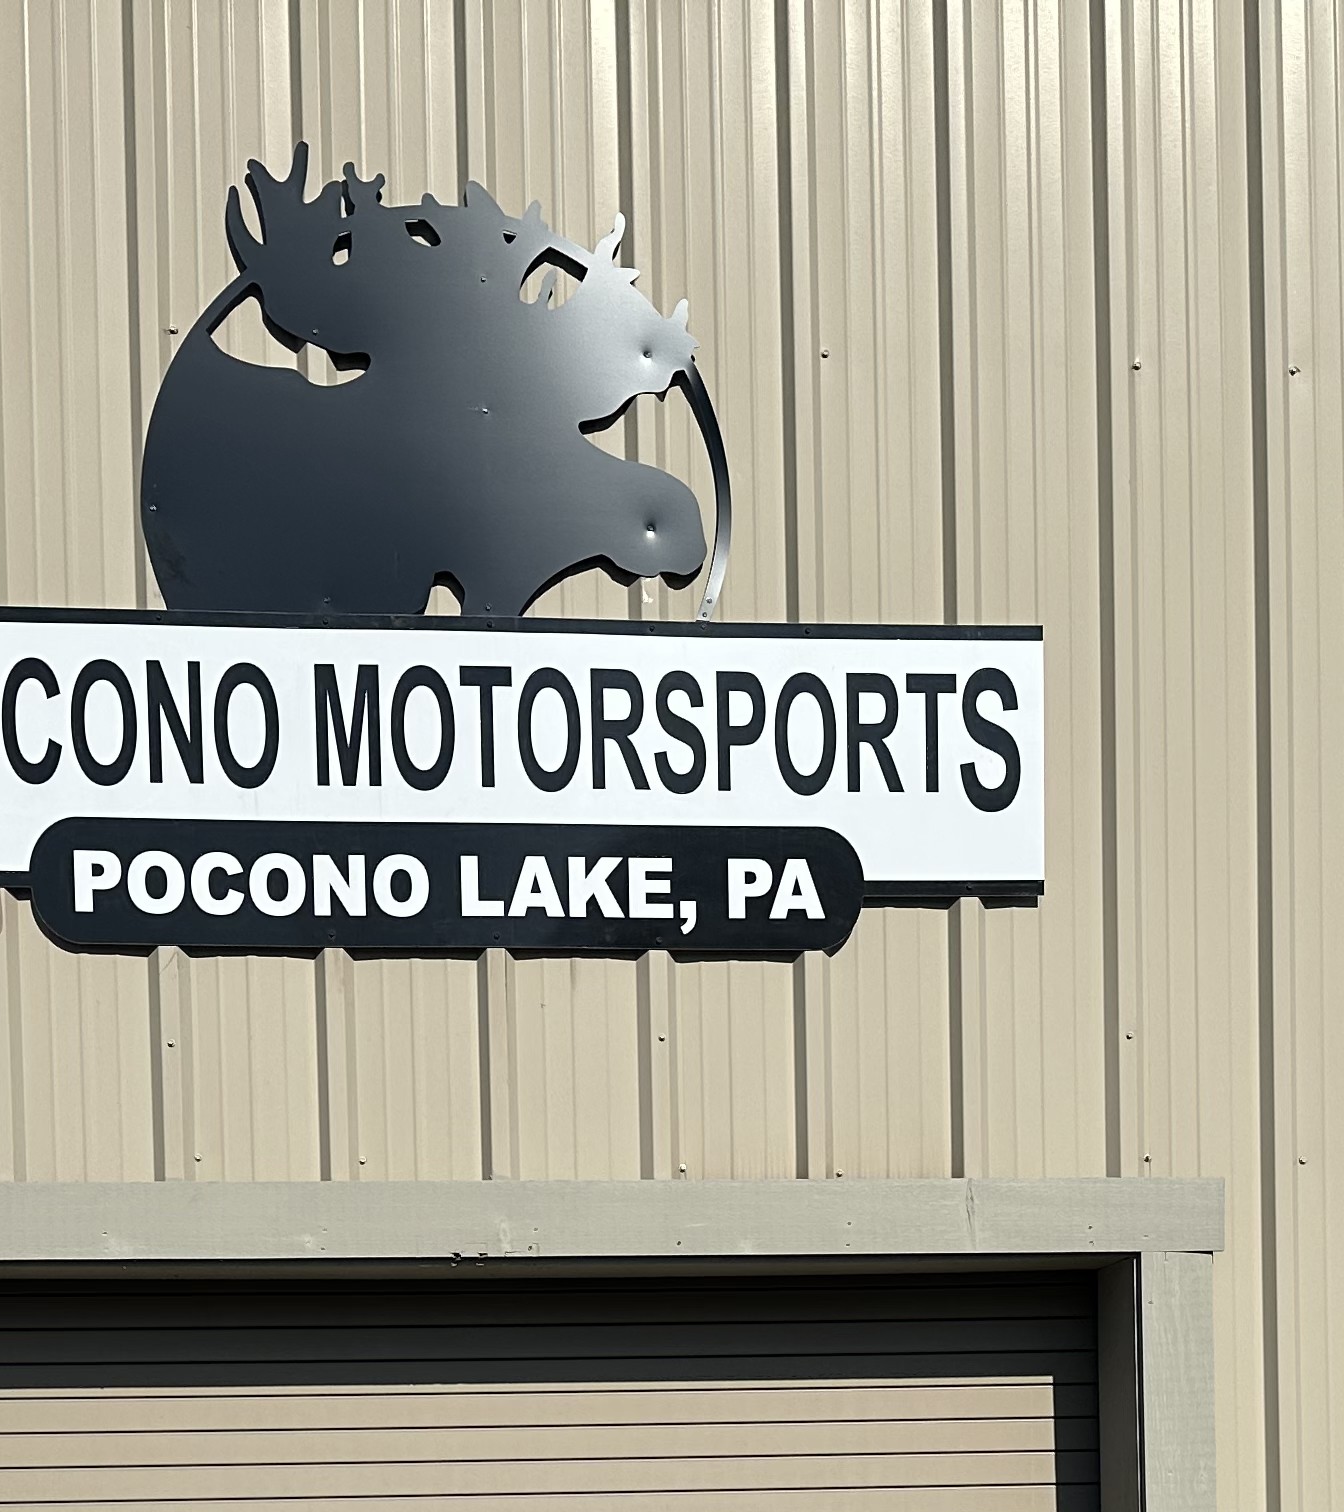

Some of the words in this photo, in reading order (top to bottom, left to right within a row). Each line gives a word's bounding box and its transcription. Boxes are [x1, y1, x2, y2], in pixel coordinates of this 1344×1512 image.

[313, 663, 1021, 813] MOTORSPORTS
[73, 849, 430, 918] POCONO
[460, 855, 697, 935] LAKE,
[727, 858, 826, 920] PA
